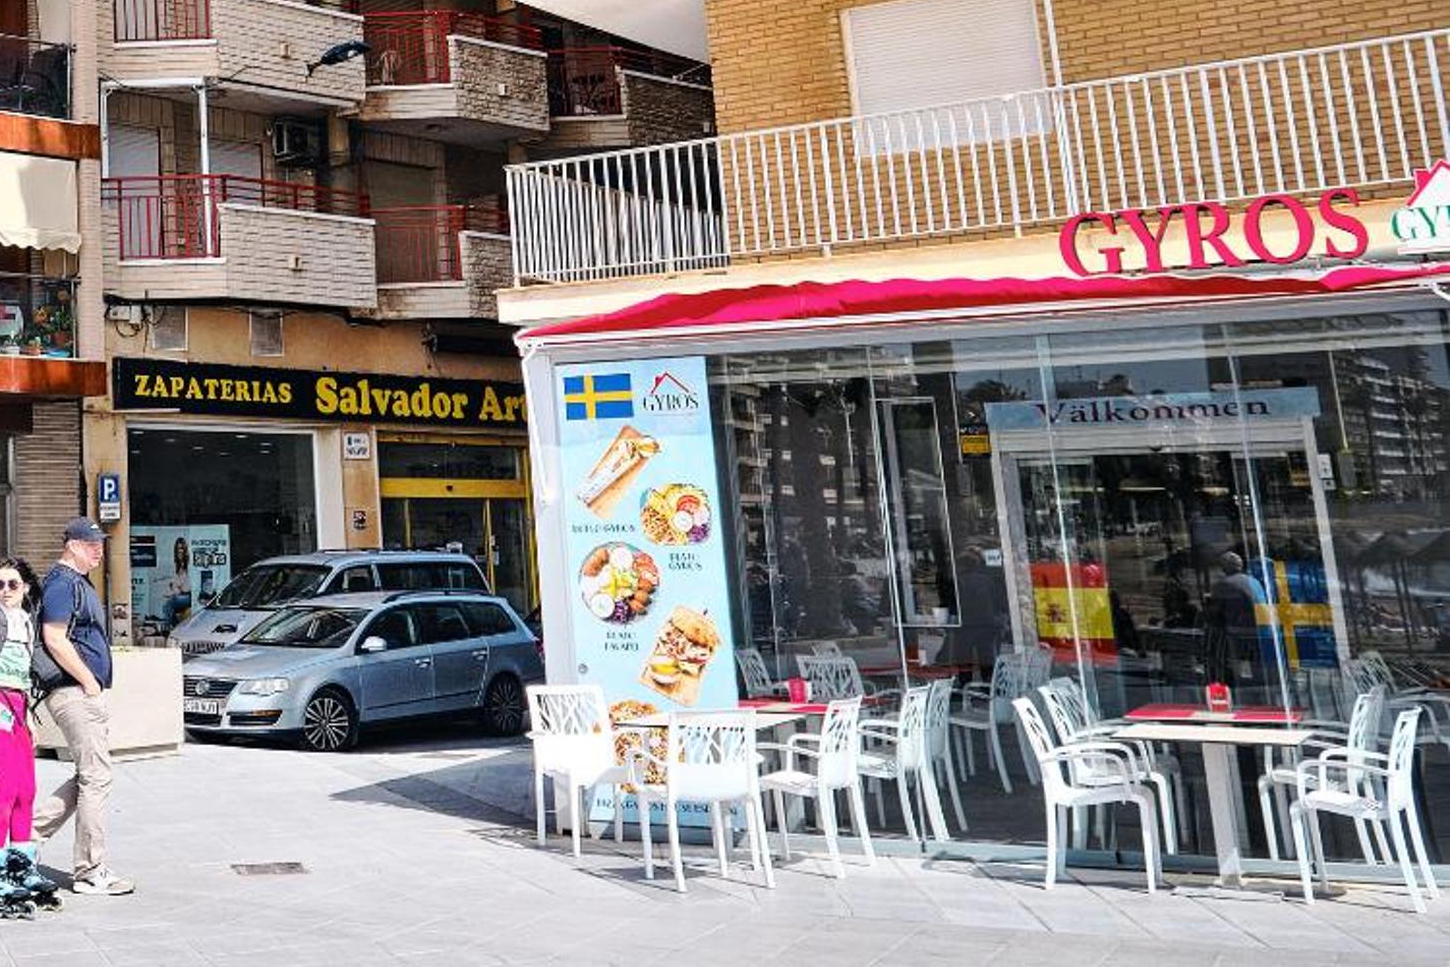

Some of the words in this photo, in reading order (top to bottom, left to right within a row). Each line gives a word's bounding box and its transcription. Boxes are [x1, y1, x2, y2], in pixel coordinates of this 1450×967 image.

[1059, 187, 1369, 277] GYROS
[1391, 204, 1450, 241] GY
[134, 374, 292, 404] ZAPATERIAS
[315, 376, 468, 419] Salvador
[642, 391, 699, 411] GYROS
[1037, 399, 1270, 425] Välkommen
[103, 478, 115, 500] P
